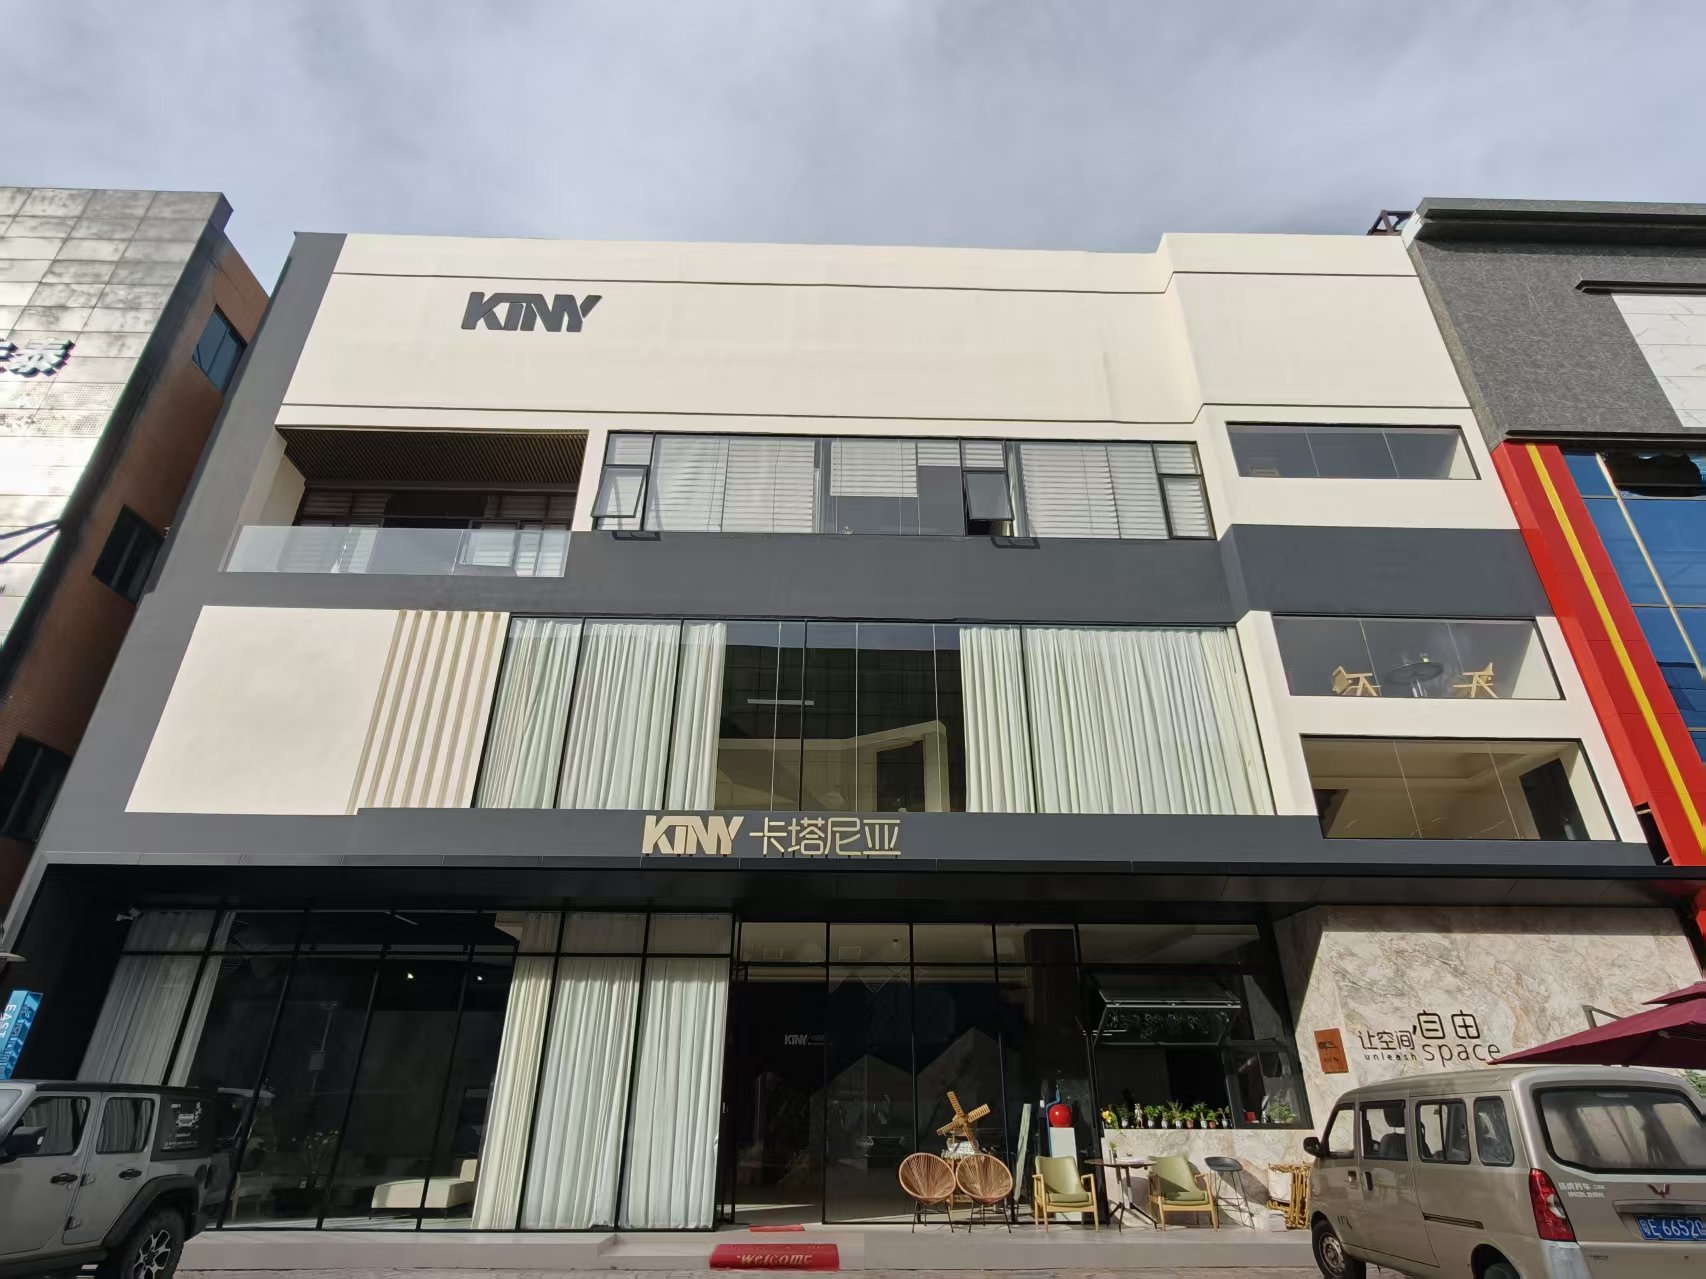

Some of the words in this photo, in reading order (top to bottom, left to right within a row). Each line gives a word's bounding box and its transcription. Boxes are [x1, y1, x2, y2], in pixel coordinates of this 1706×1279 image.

[749, 817, 901, 856] 卡塔尼亚
[1364, 1052, 1418, 1061] unleash
[1422, 1043, 1501, 1067] space
